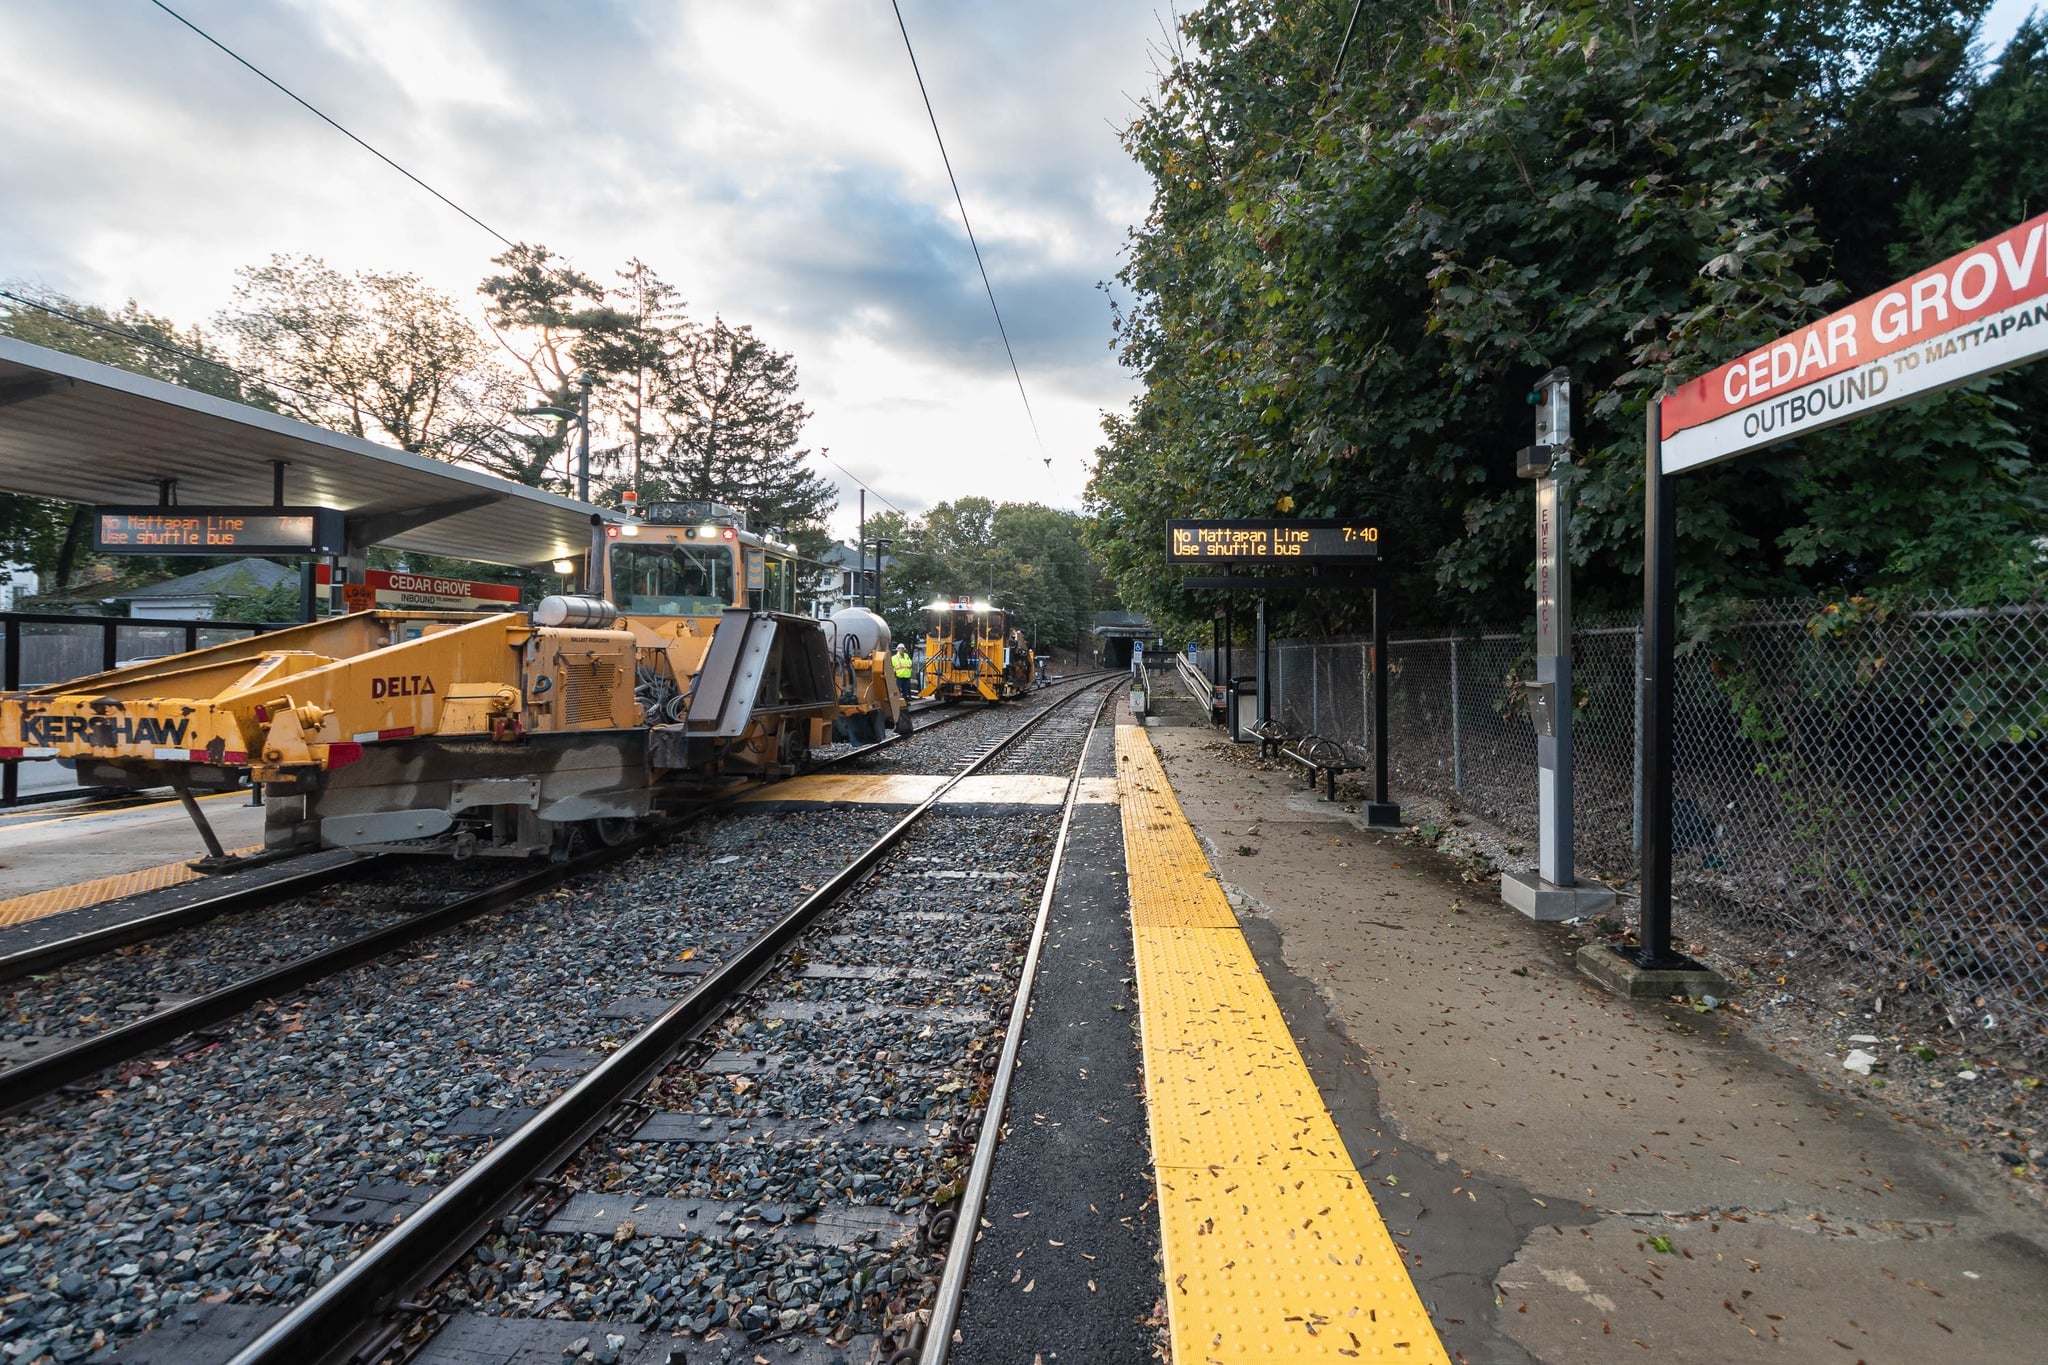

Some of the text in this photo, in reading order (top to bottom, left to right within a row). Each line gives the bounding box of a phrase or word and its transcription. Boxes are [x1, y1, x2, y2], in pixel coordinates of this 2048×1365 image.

[1724, 221, 2048, 405] CEDAR GROV
[1744, 303, 2048, 438] OUTBOUND TO MATTAPAN
[101, 515, 120, 530] No
[128, 515, 200, 531] Mattapan
[207, 515, 244, 531] Line
[101, 530, 235, 545] Use shuttle bus
[1173, 527, 1378, 543] No Mattapan Line 7:40
[1173, 542, 1301, 556] Use shuttle bus
[1541, 508, 1549, 636] EMERGENCY
[389, 574, 472, 596] CEDAR GROVE
[401, 593, 435, 605] INBOUND
[372, 675, 435, 698] DELTA
[20, 715, 190, 747] KERSHAW
